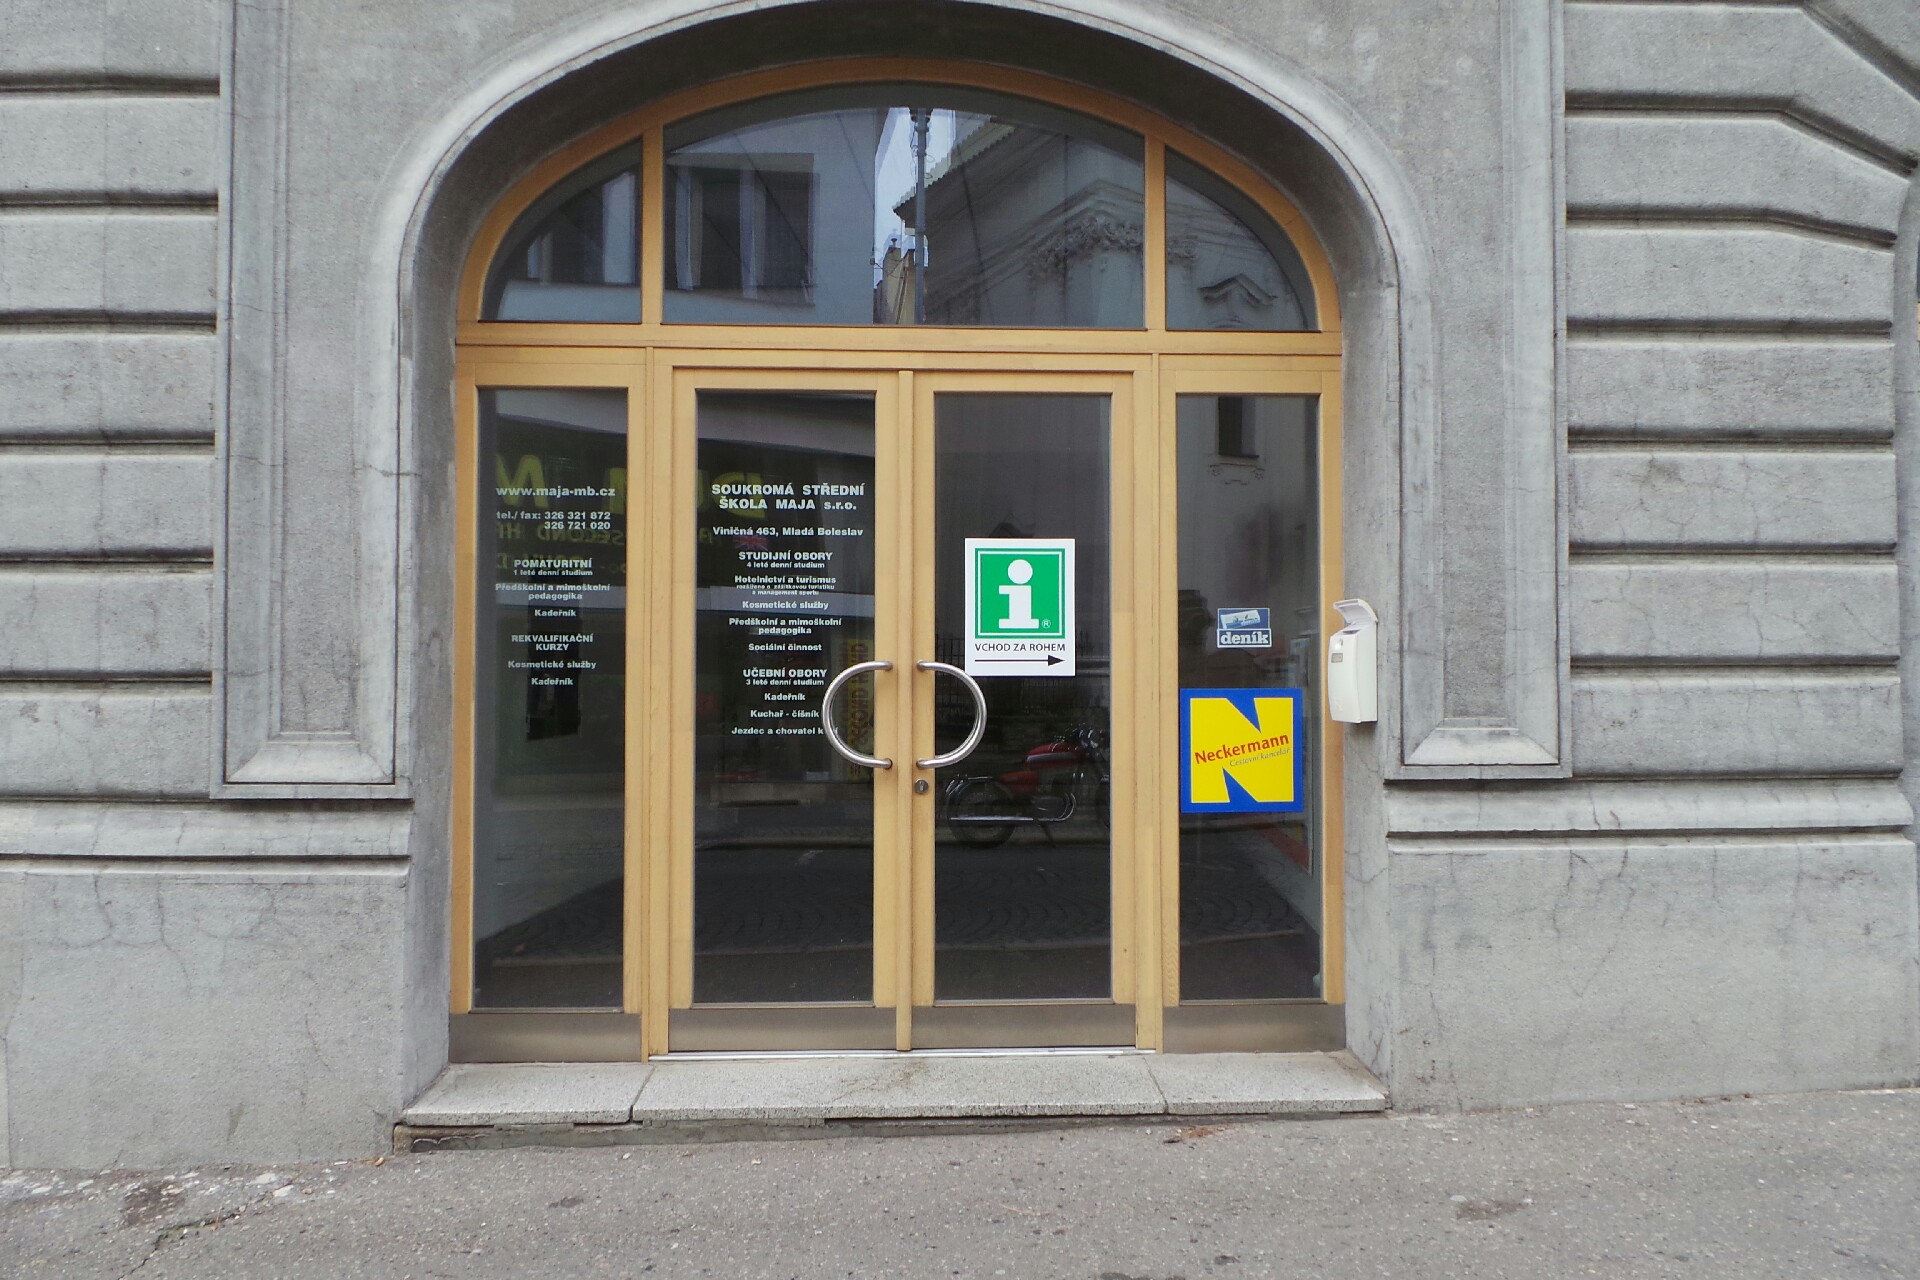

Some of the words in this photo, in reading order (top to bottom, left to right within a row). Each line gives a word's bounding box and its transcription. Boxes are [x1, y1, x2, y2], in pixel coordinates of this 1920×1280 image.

[496, 485, 616, 498] www.maja-mb.cz
[711, 483, 795, 496] SOUKROMÁ
[802, 483, 865, 496] STŘEDNÍ
[719, 496, 767, 509] ŠKOLA
[775, 499, 816, 509] MAJA
[823, 501, 857, 510] s.r.o.
[520, 511, 541, 520] fax:
[544, 512, 564, 520] 326
[567, 512, 586, 520] 321
[590, 512, 611, 520] 872
[544, 522, 564, 530] 326
[567, 522, 586, 530] 721
[590, 522, 611, 530] 020
[712, 526, 753, 536] Viničná
[756, 527, 779, 537] 463,
[782, 527, 814, 536] Mladá
[818, 527, 863, 536] Boleslav
[738, 550, 791, 561] STUDIJNÍ
[794, 552, 833, 561] OBORY
[513, 558, 592, 568] POMATURITNÍ
[734, 575, 786, 584] Hotelnictví
[787, 576, 794, 584] a
[795, 575, 837, 584] turismus
[495, 583, 545, 591] Předškolní
[556, 583, 611, 591] mimoškolní
[528, 592, 583, 601] pedagogika
[742, 600, 797, 609] Kosmetické
[799, 600, 829, 610] služby
[534, 609, 577, 617] Kadeřník
[729, 617, 778, 626] Předškolní
[788, 617, 842, 626] mimoškolní
[758, 626, 812, 636] pedagogika
[511, 633, 594, 643] REKVALIFIKAČNÍ
[1220, 631, 1269, 645] deník
[535, 643, 570, 651] KURZY
[748, 642, 785, 651] Sociální
[787, 642, 822, 651] činnost
[975, 643, 1011, 652] VCHOD
[1013, 643, 1027, 652] ZA
[1029, 643, 1066, 652] ROHEM
[508, 660, 564, 669] Kosmetické
[566, 660, 597, 670] služby
[743, 667, 786, 678] UČEBNÍ
[788, 669, 828, 678] OBORY
[531, 677, 574, 685] Kadeřník
[764, 693, 806, 701] Kadeřník
[750, 709, 784, 718] Kuchař
[791, 709, 819, 718] číšník
[731, 727, 765, 735] Jezdec
[775, 727, 816, 735] chovatel
[1194, 734, 1289, 765] Neckermann
